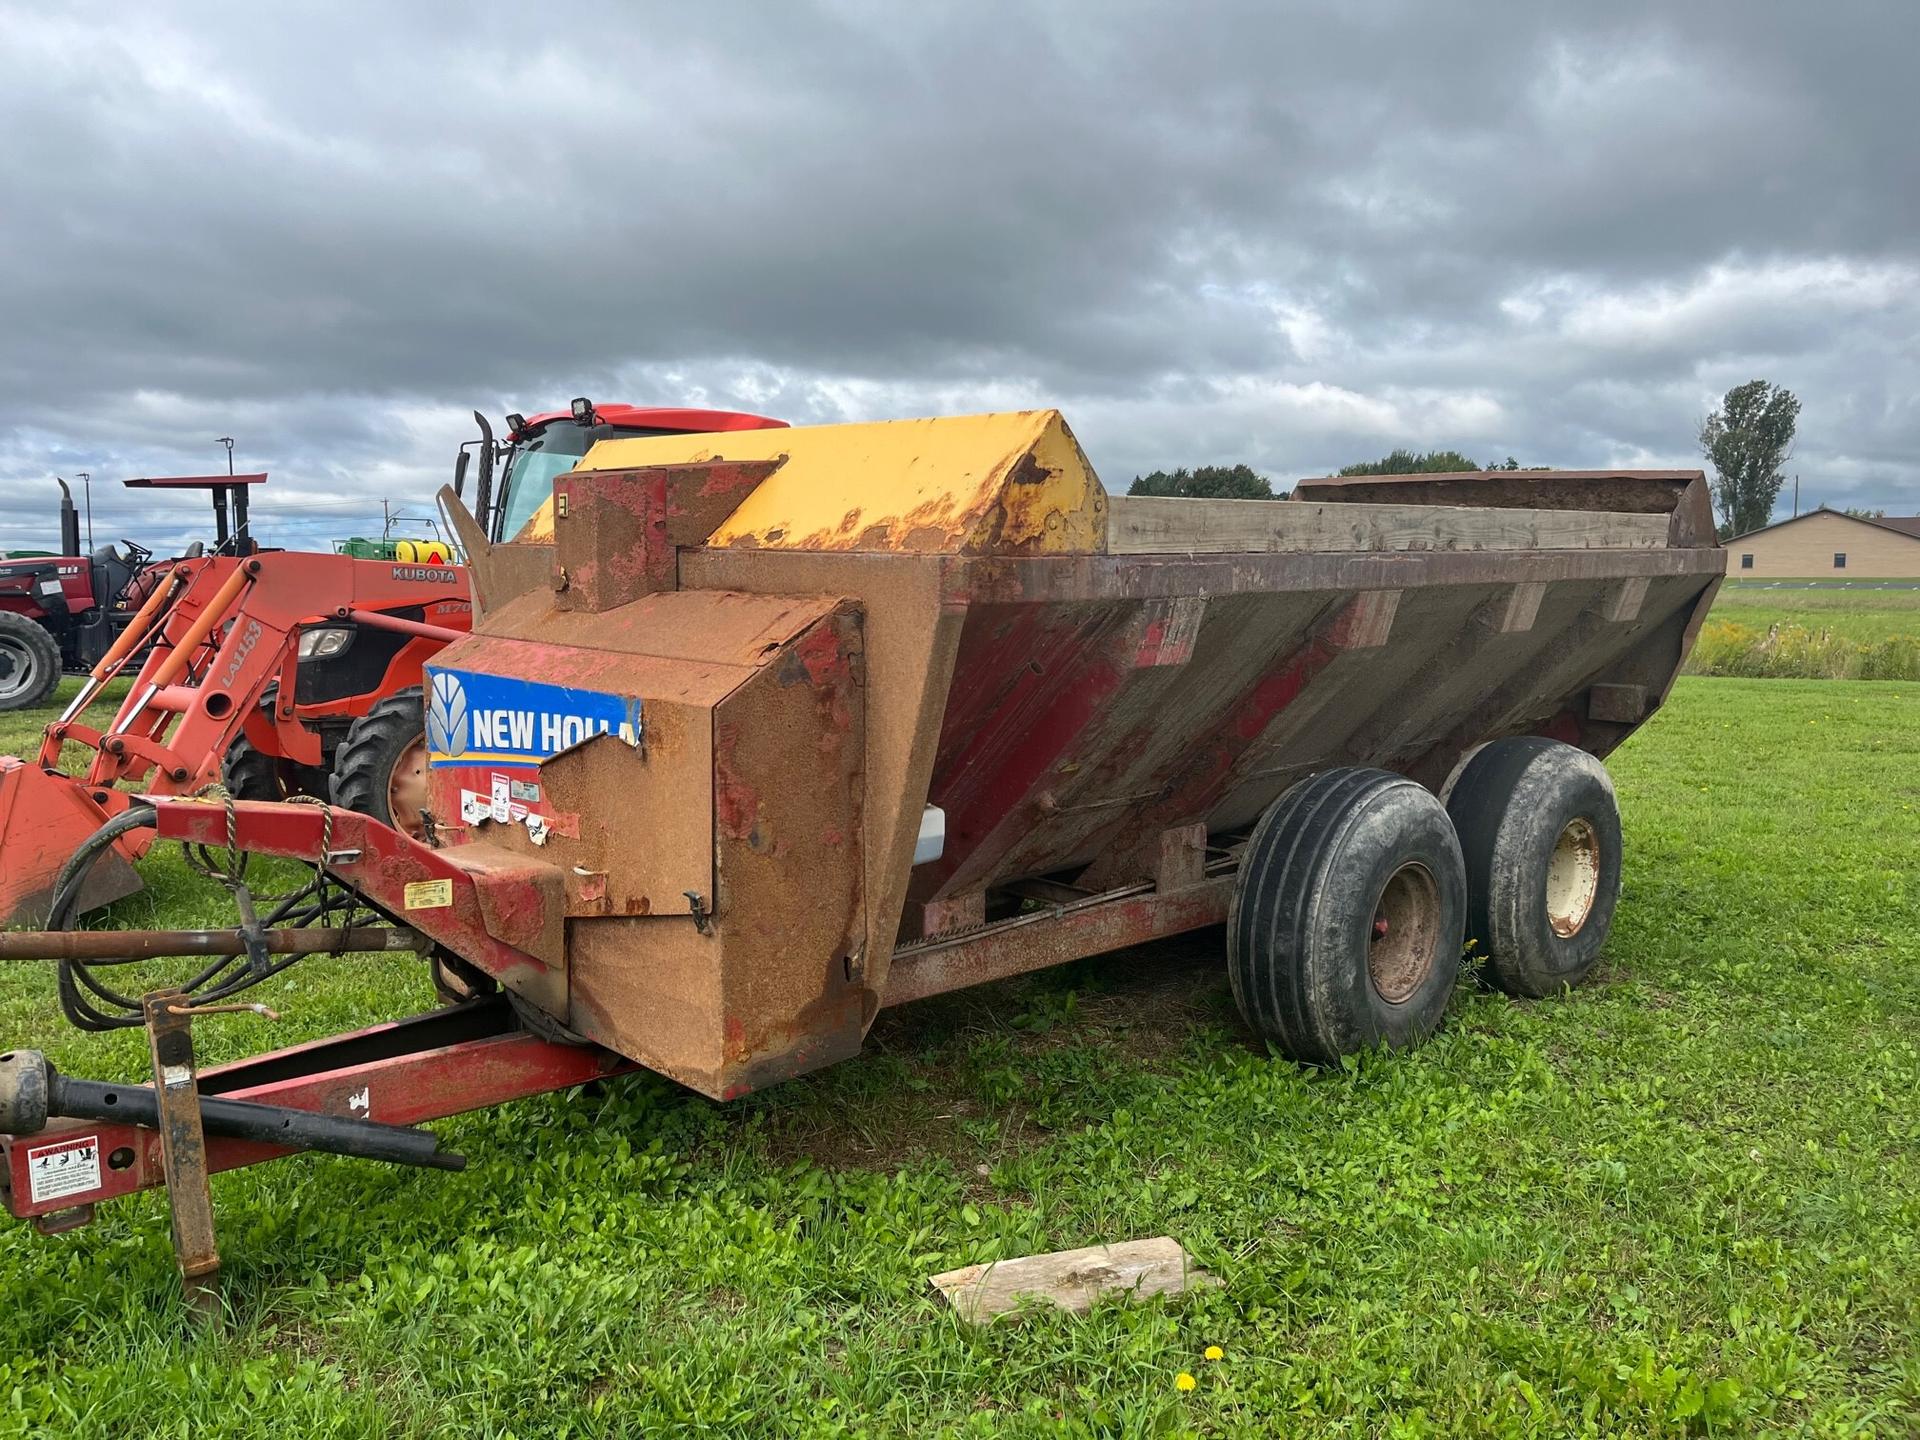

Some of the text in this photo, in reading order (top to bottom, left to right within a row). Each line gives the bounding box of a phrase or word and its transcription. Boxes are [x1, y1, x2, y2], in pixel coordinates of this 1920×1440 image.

[392, 567, 456, 584] KUBOTA
[221, 621, 262, 688] LA1153
[473, 710, 636, 753] NEW HOA
[43, 1141, 88, 1155] WARNING
